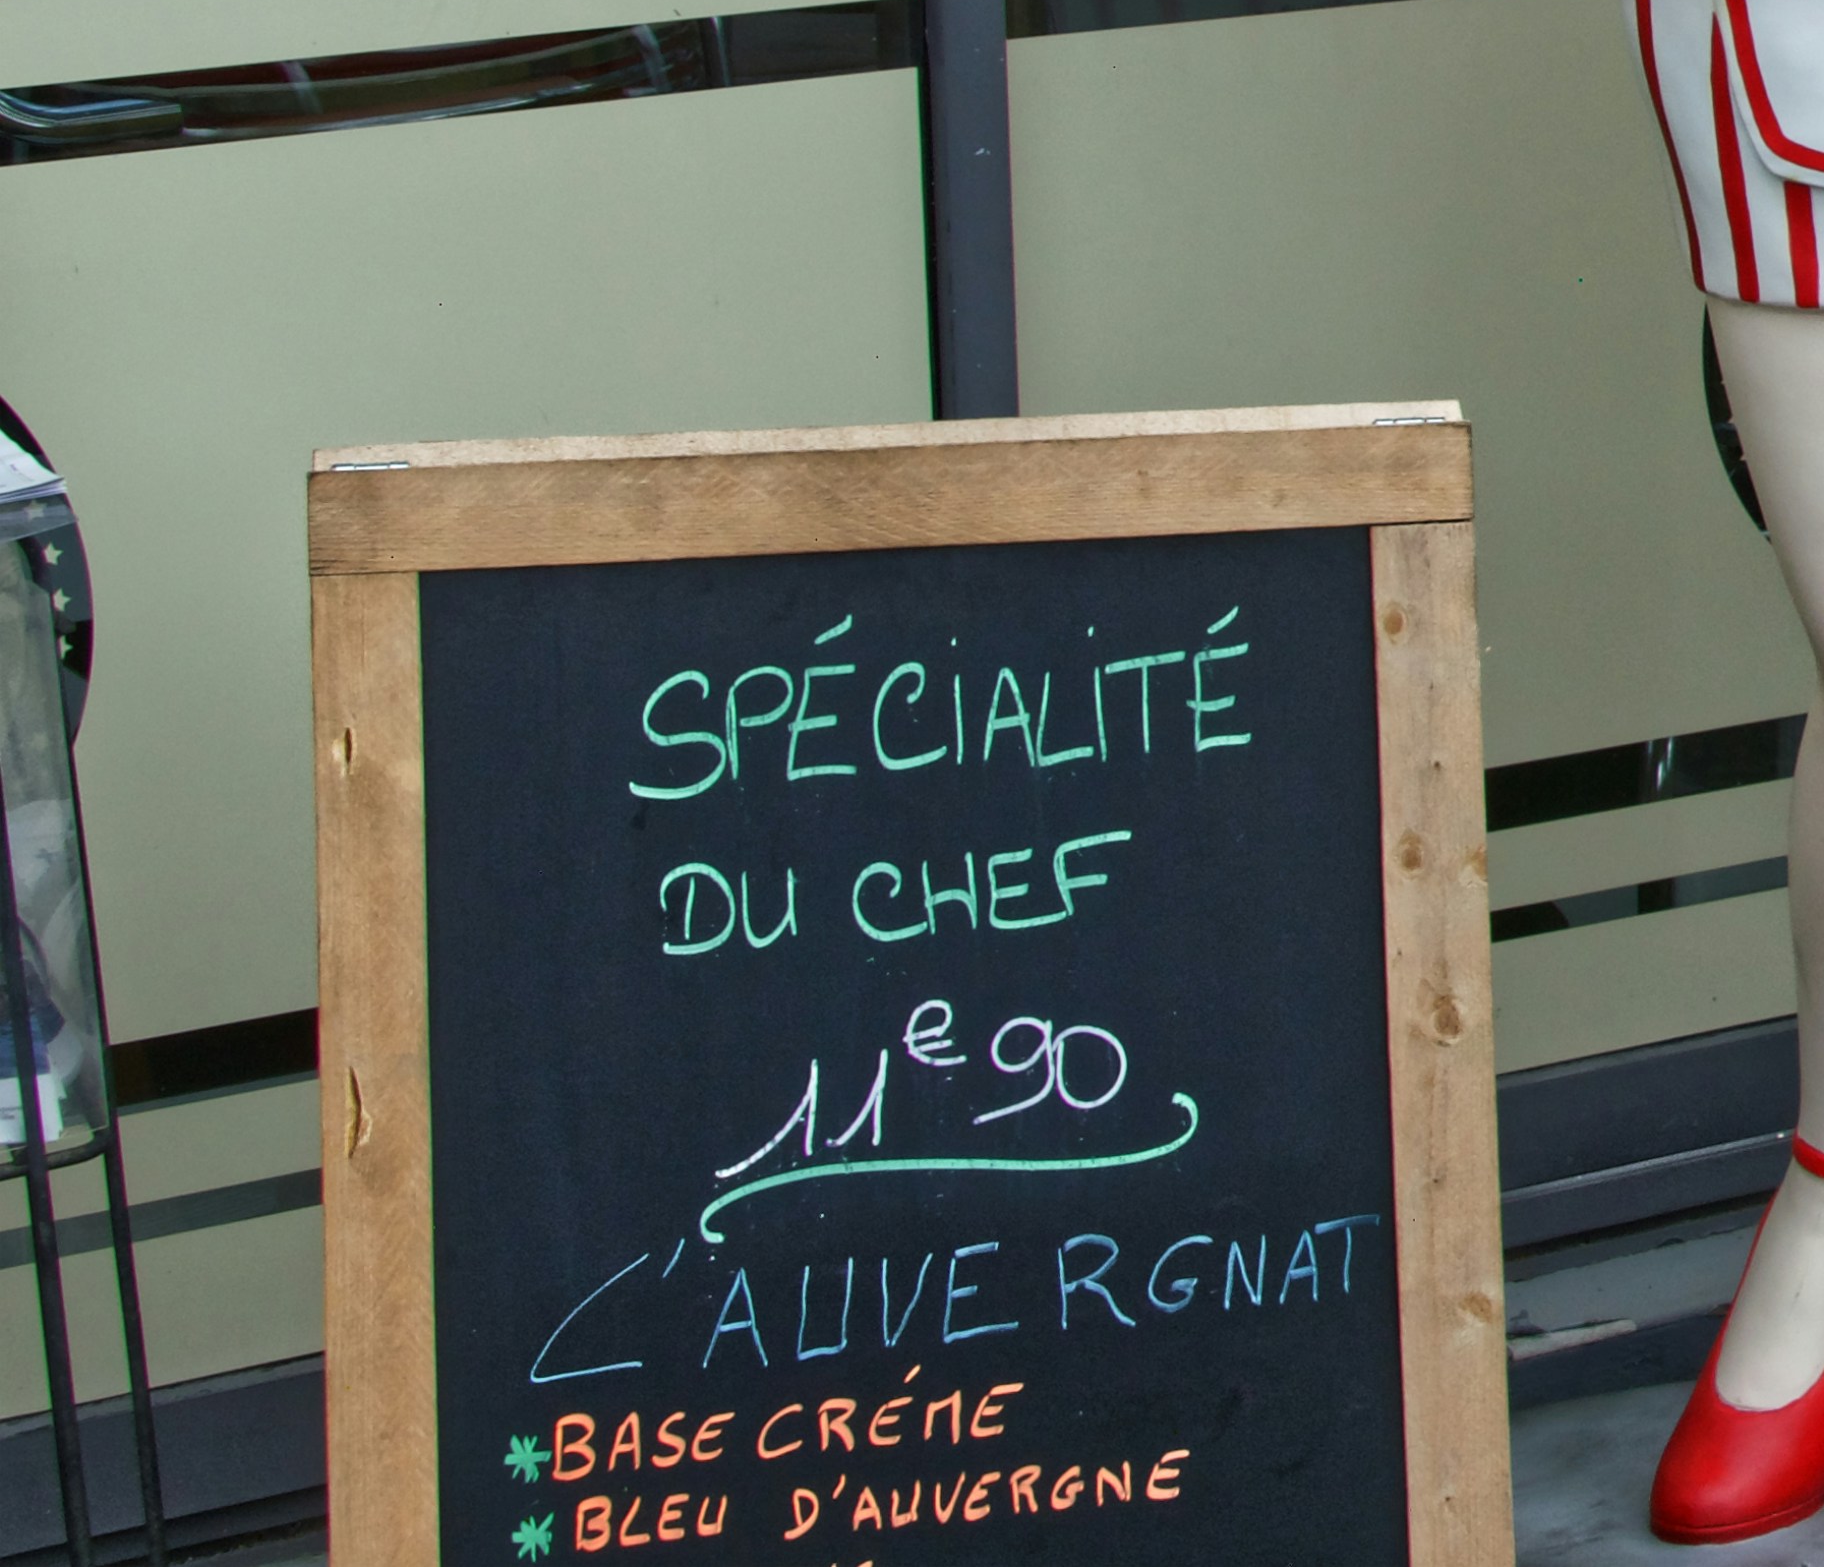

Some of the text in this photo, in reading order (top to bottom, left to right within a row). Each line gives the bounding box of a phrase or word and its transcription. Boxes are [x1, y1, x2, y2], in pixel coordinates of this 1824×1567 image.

[627, 605, 1254, 802] SPÉCIALITÉ
[659, 830, 1134, 956] DU CHEF
[551, 1410, 736, 1483] BASE
[574, 1490, 730, 1553] BLEU
